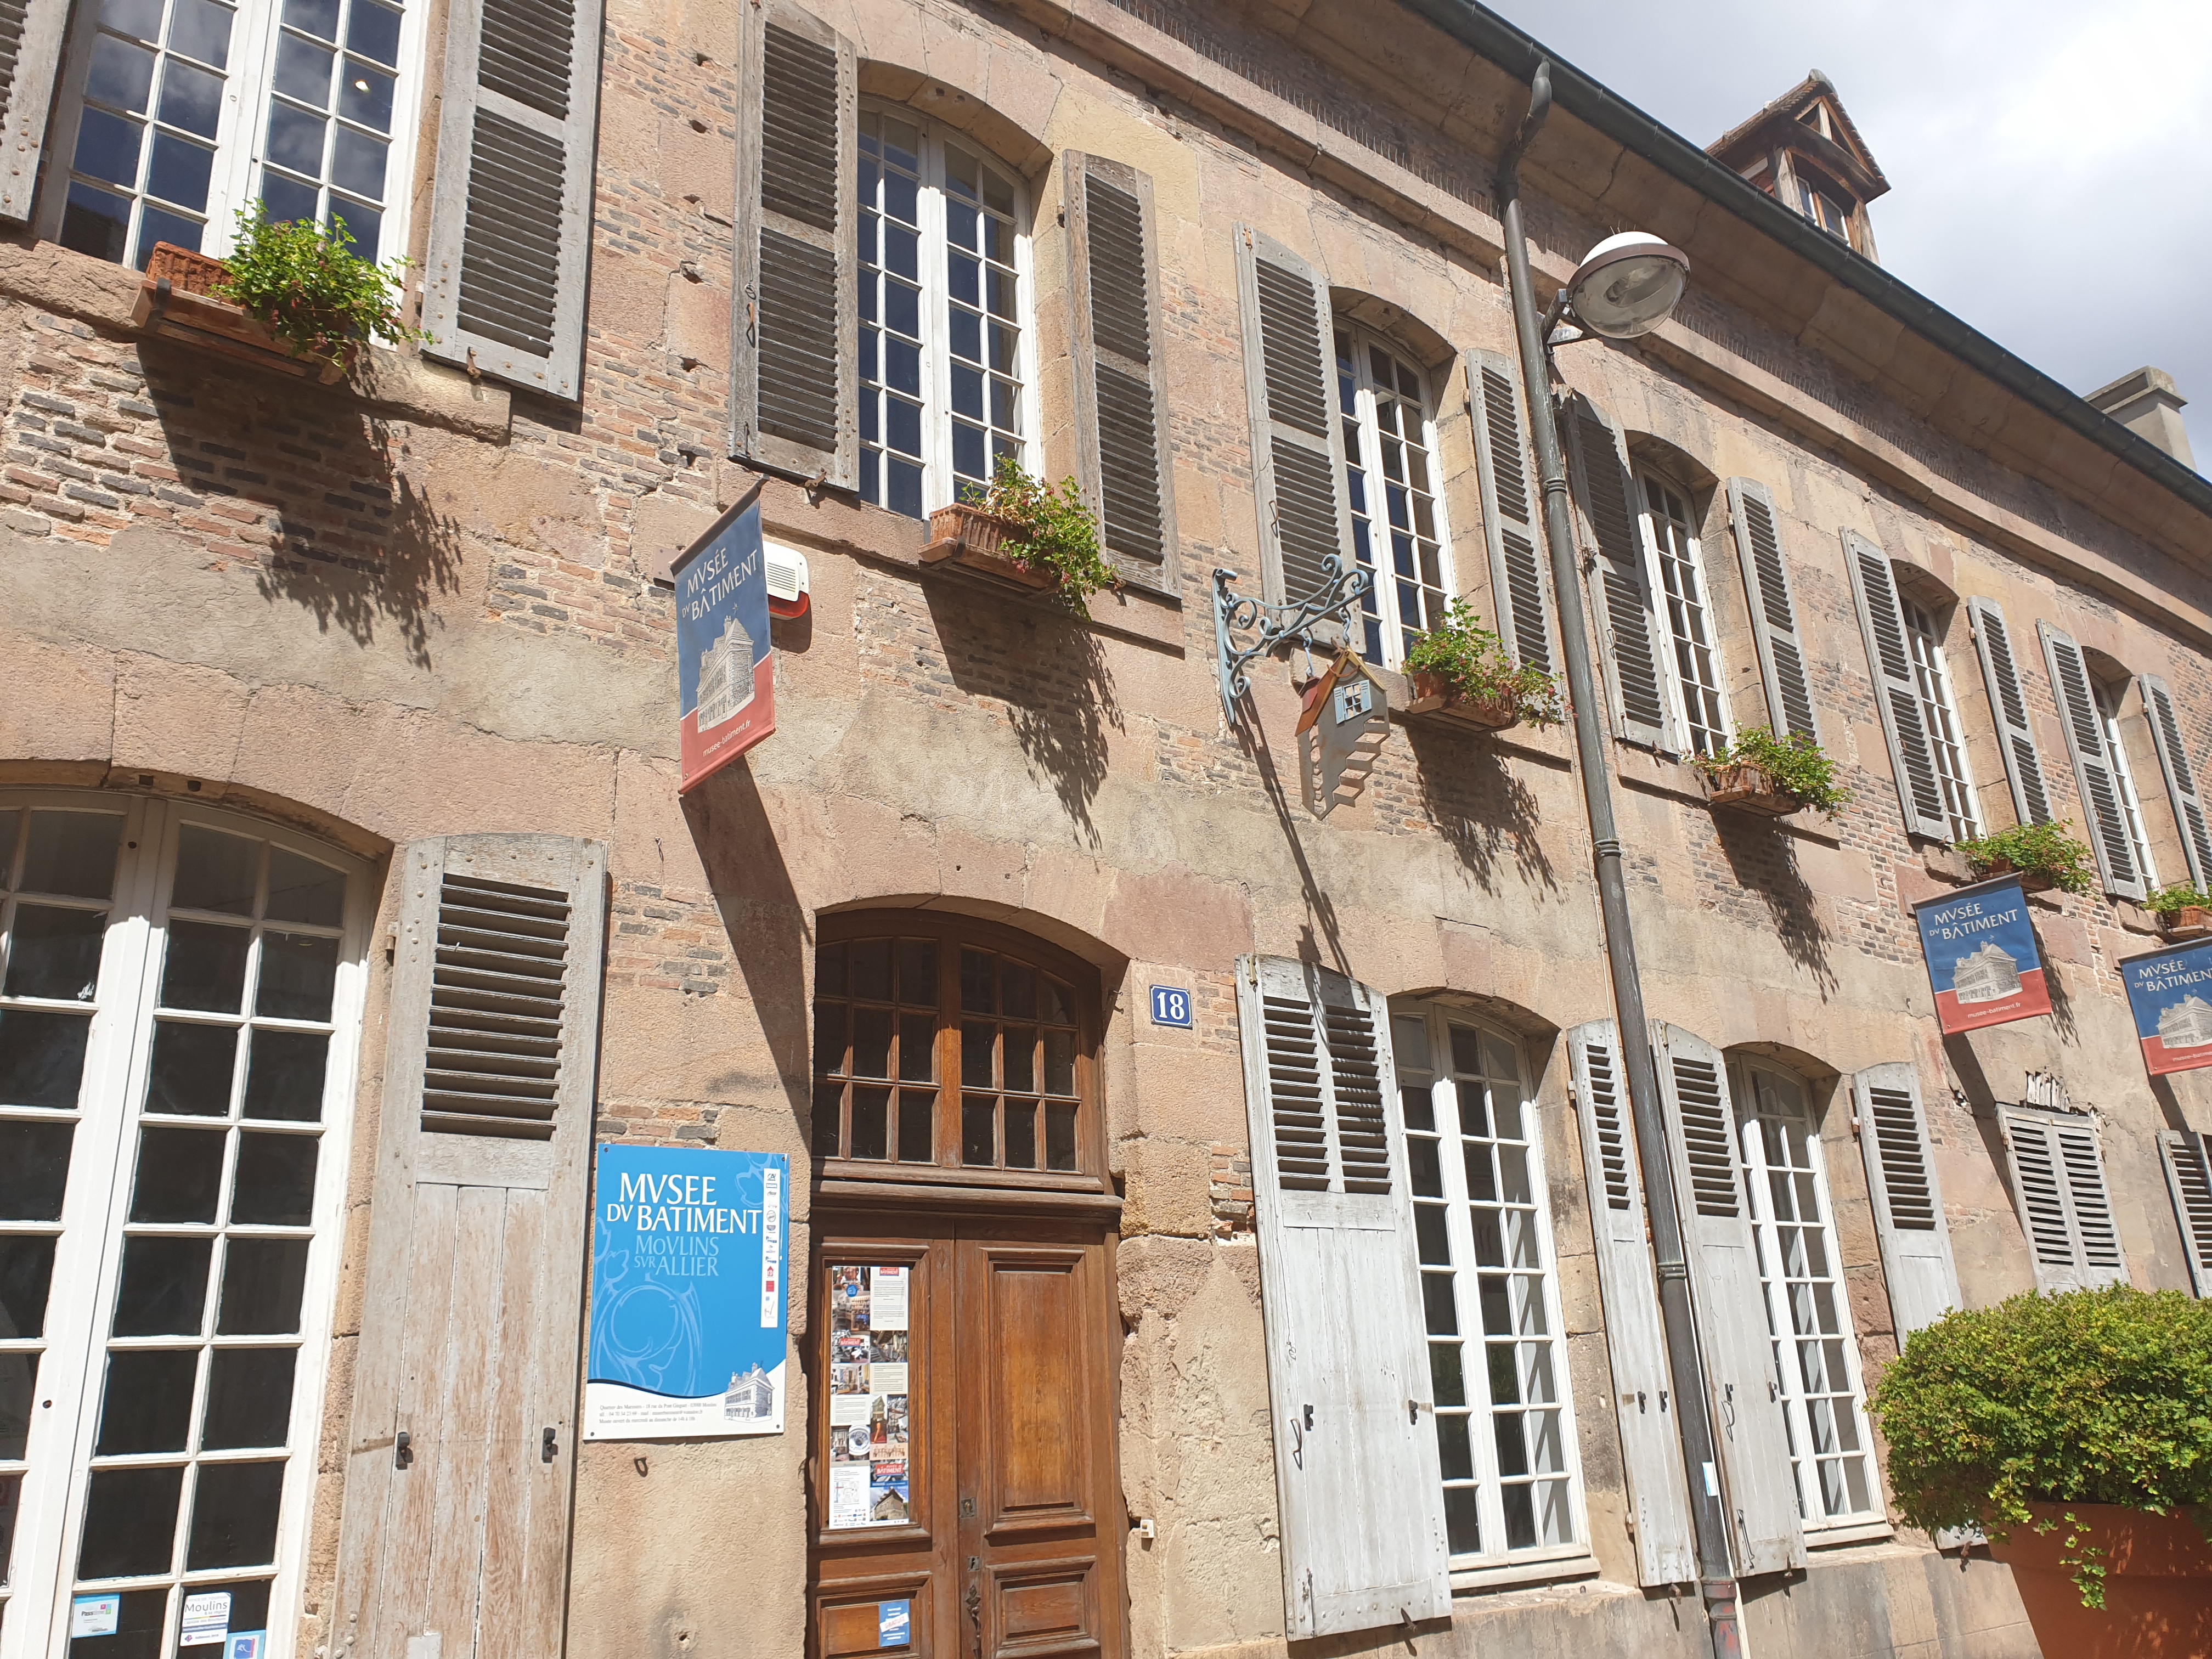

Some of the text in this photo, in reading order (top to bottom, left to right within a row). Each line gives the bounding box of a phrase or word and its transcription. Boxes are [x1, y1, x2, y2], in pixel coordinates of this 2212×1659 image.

[692, 549, 757, 621] BÂTIMENT
[703, 719, 751, 757] musee-batiment.fr
[1942, 909, 2018, 939] BÂTIMENT
[2146, 968, 2212, 991] BÂTIMEN
[1157, 992, 1184, 1019] 18
[1967, 1002, 2021, 1018] musee-batiment.fr
[619, 1172, 716, 1205] MVSEE
[607, 1204, 634, 1222] DV
[636, 1205, 763, 1234] BATIMENT
[655, 1256, 719, 1277] ALLIER
[185, 1601, 228, 1612] Moulins
